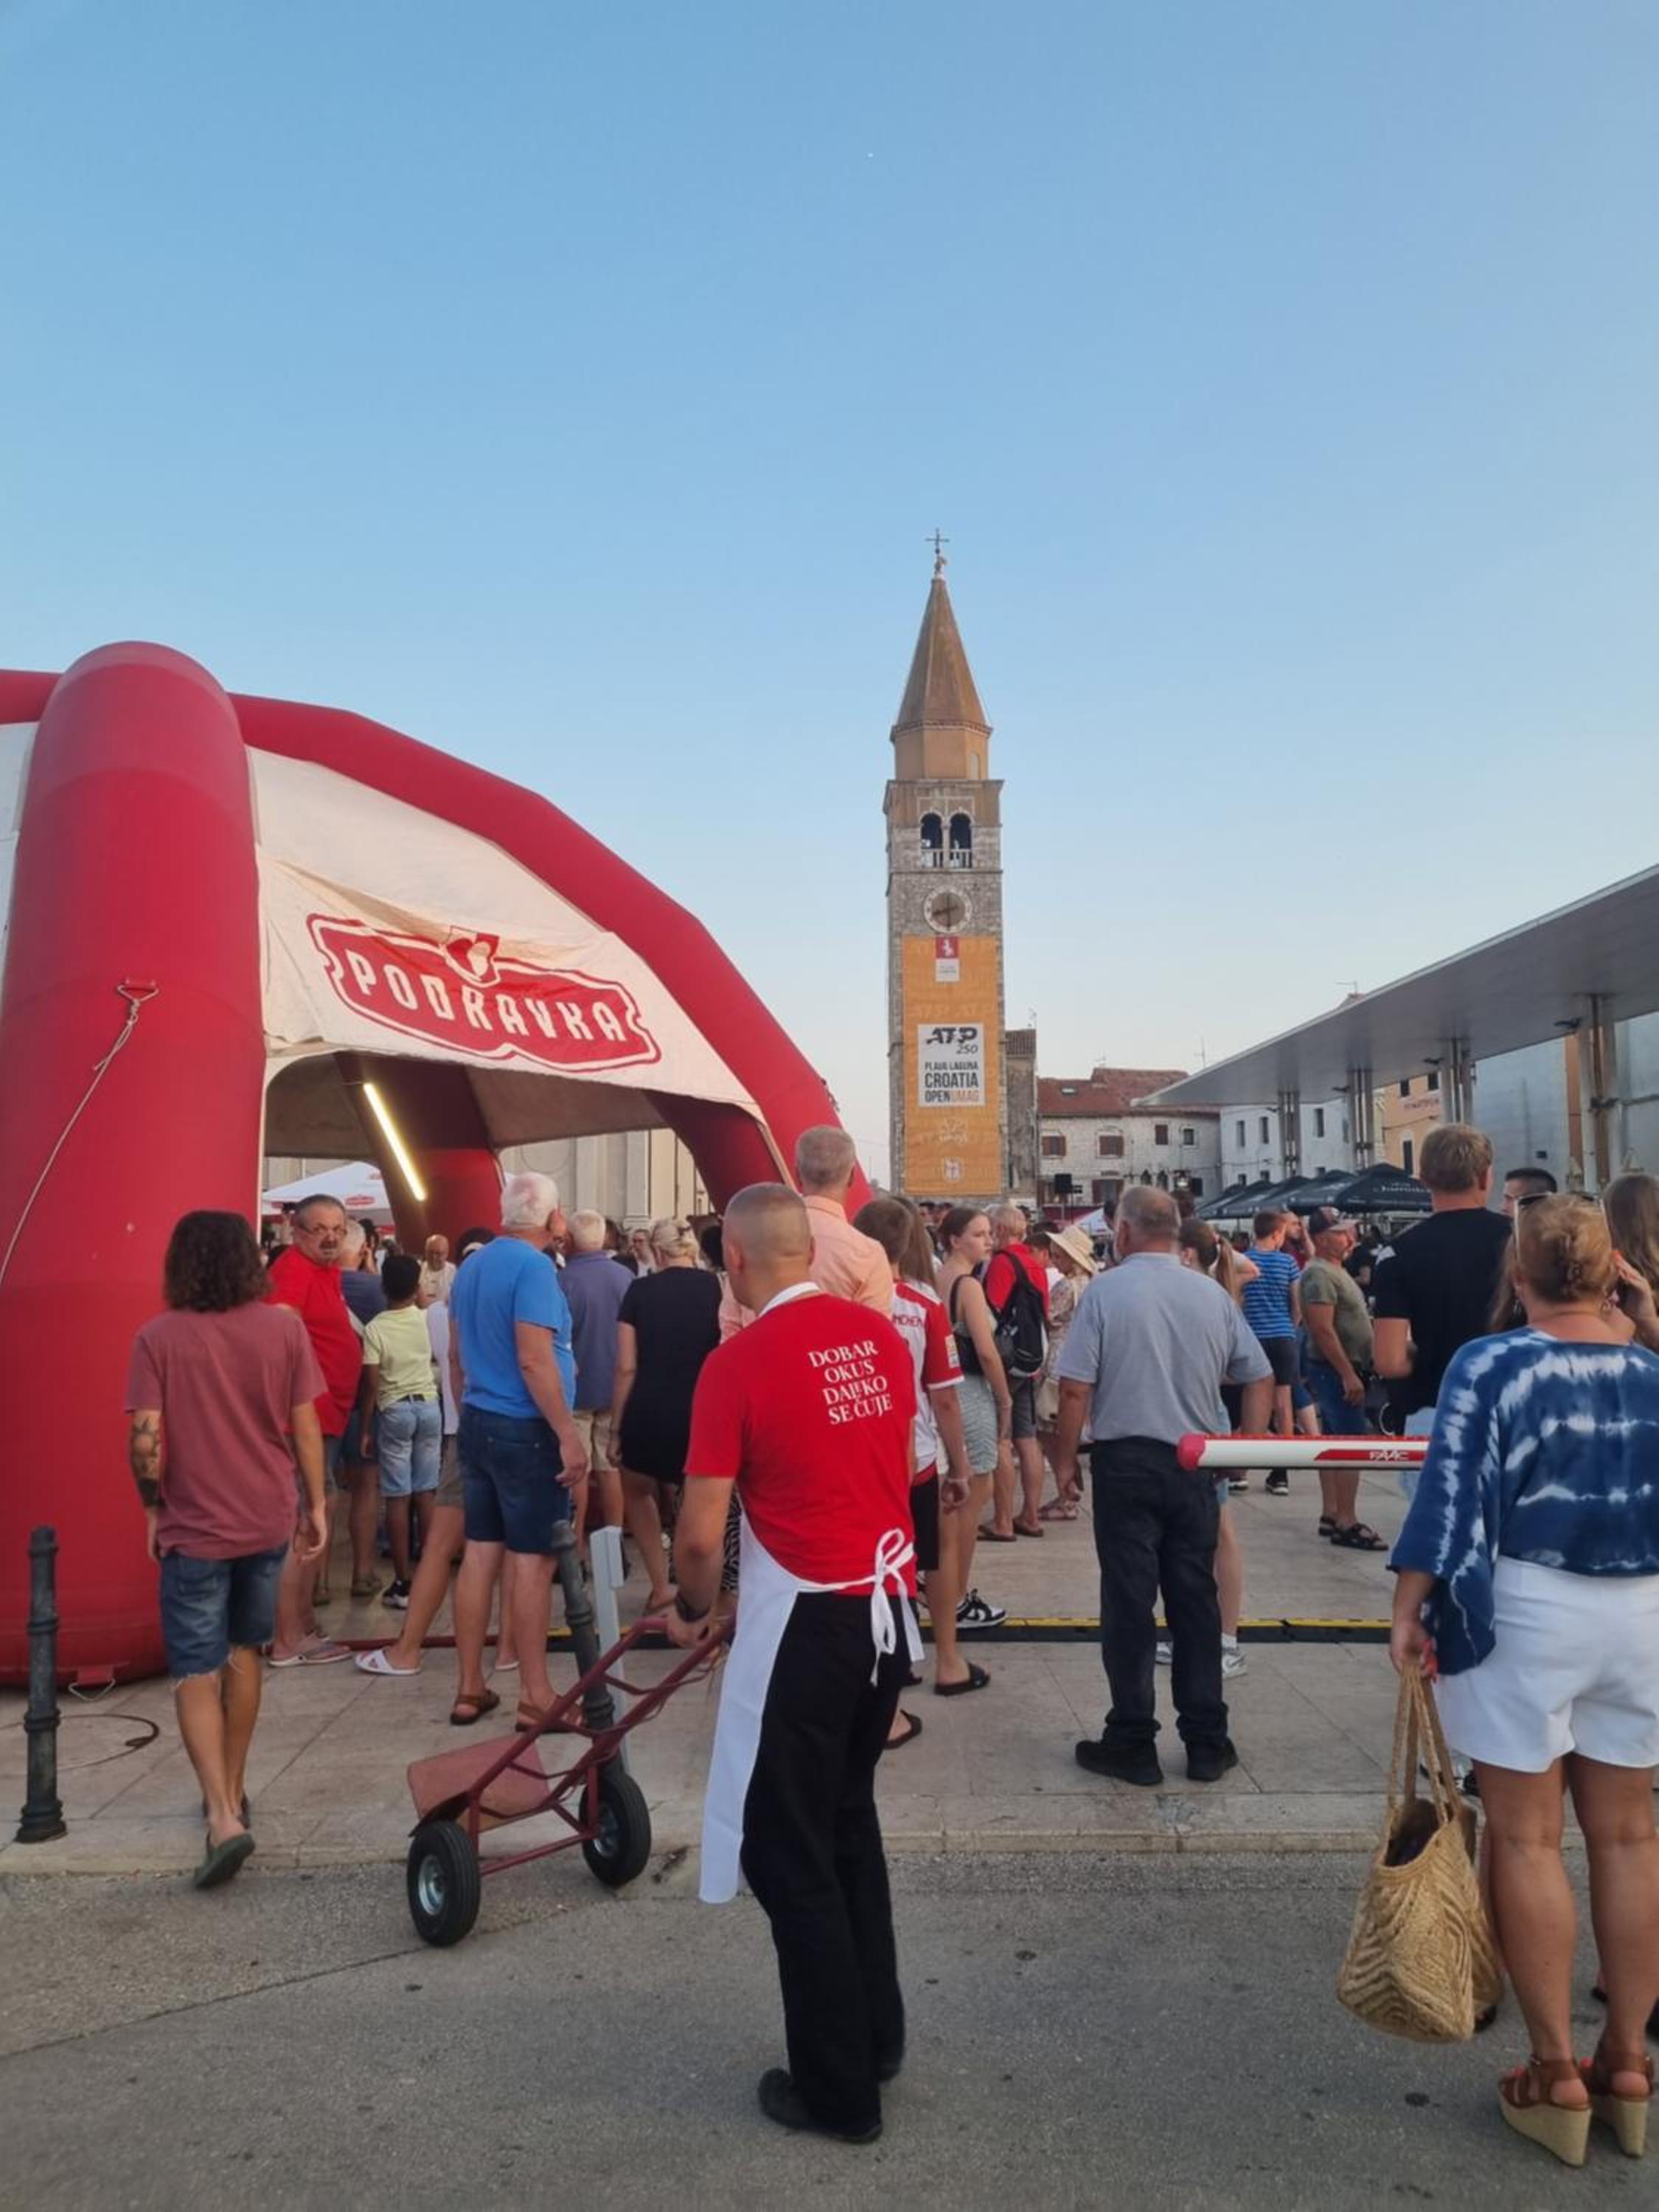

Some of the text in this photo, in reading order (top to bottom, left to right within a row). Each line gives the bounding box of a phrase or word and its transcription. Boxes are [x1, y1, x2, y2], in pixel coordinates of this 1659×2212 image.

[346, 949, 627, 1042] PODRAVKA
[926, 1027, 978, 1044] ATP
[956, 1044, 978, 1054] 250
[924, 1072, 979, 1088] CROATIA
[808, 1340, 879, 1368] DOBAR
[824, 1359, 875, 1384] OKUS
[822, 1376, 888, 1405] DALEKO
[828, 1394, 894, 1425] SE ČUJE
[1369, 1450, 1409, 1461] FAAC
